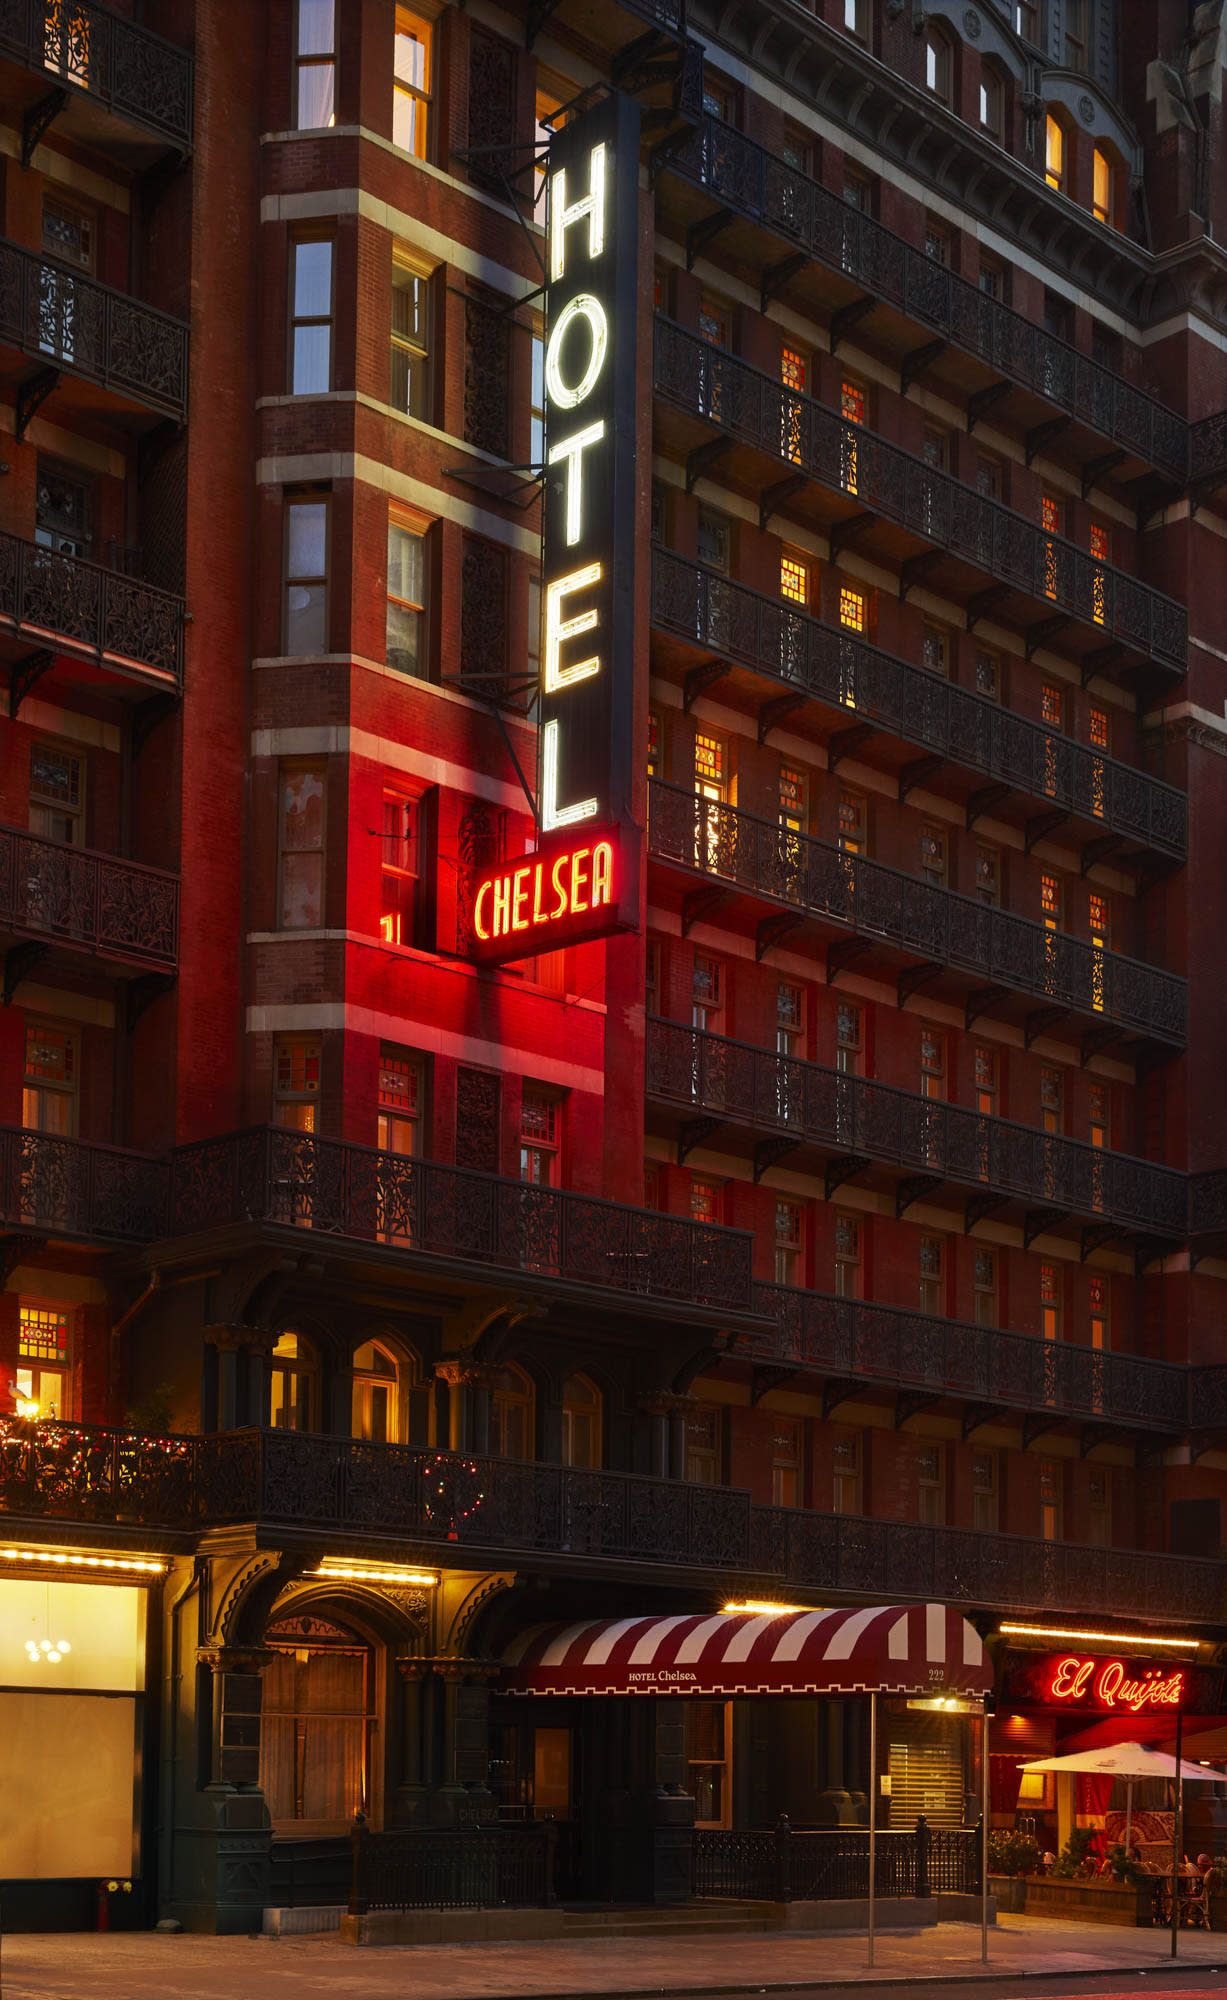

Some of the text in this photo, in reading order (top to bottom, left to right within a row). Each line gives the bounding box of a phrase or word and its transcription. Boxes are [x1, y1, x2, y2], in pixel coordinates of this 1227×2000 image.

[542, 142, 608, 832] HOTEL
[474, 841, 613, 940] CHELSEA
[629, 1670, 697, 1681] HOTEL Chelsea
[928, 1669, 944, 1681] 222
[1051, 1658, 1183, 1711] El Quijote
